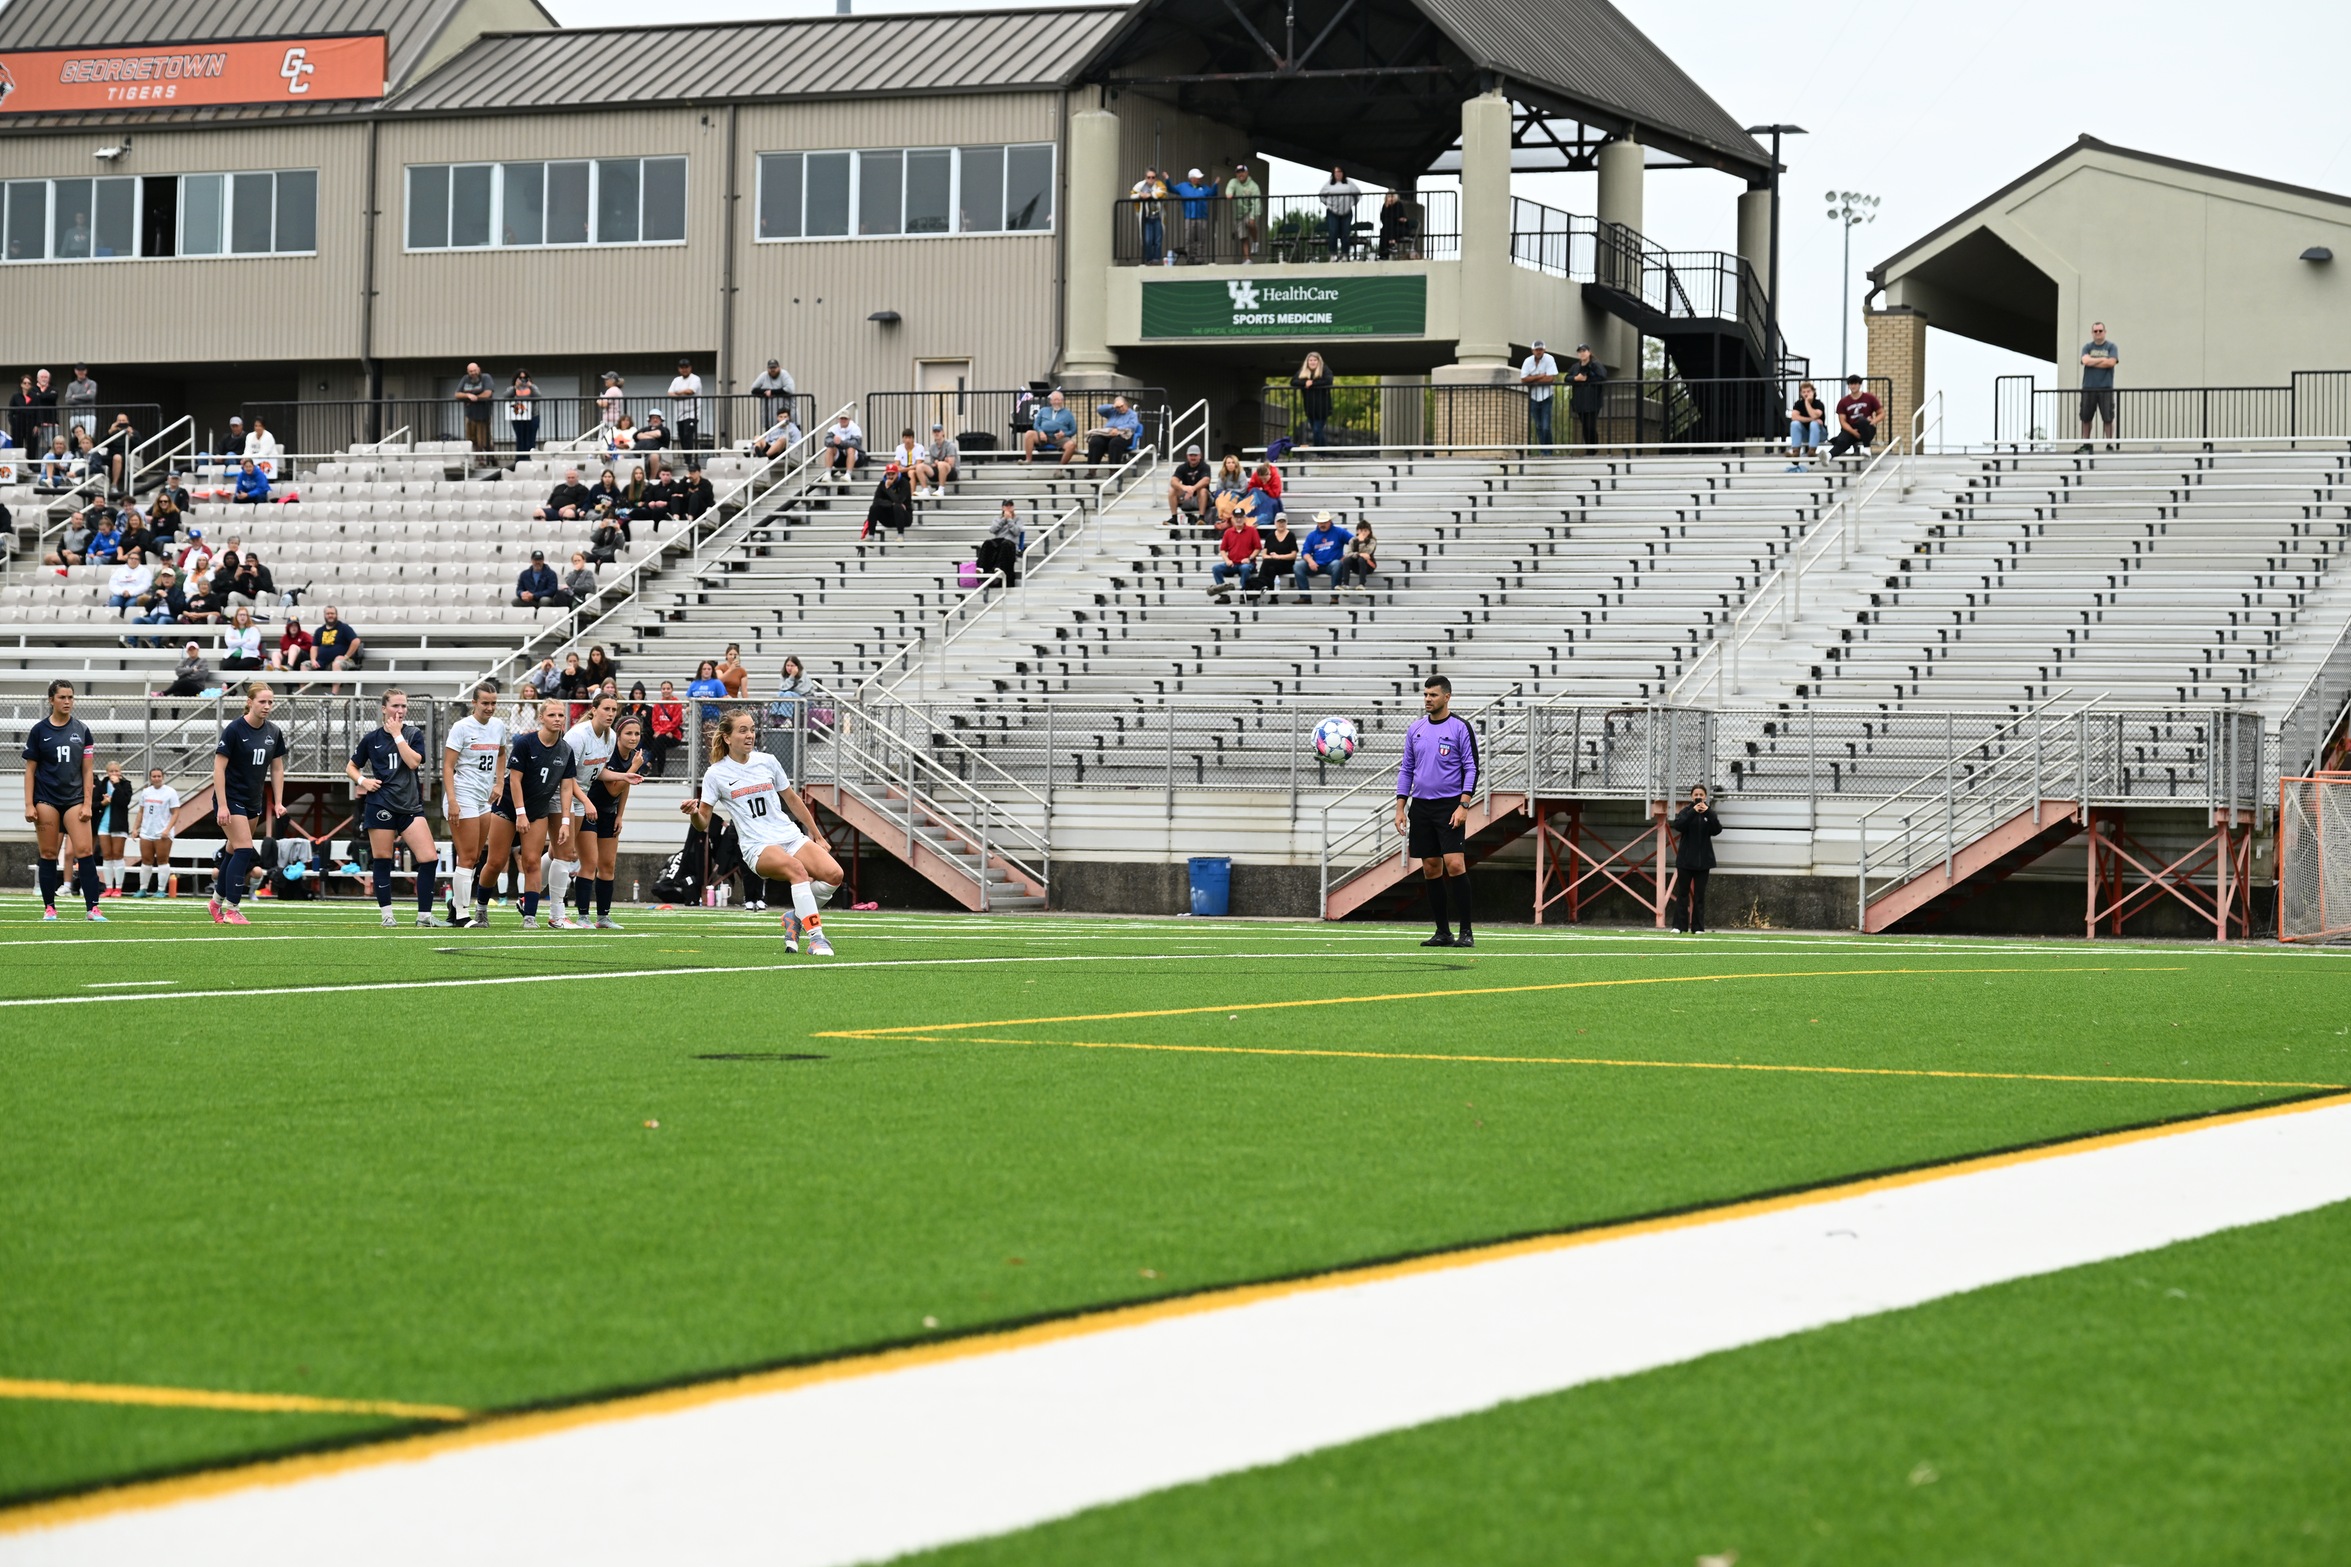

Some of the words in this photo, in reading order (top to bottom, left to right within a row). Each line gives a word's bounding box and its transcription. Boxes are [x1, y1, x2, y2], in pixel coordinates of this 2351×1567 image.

[59, 53, 227, 84] GEORGETOWN
[107, 85, 177, 100] TIGERS
[1227, 280, 1260, 310] UK
[1262, 286, 1339, 301] HealthCare
[1232, 313, 1275, 325] SPORTS
[1277, 313, 1333, 324] MEDICINE
[56, 745, 70, 763] 19
[252, 748, 266, 765] 10
[388, 752, 398, 769] 11
[478, 755, 494, 771] 22
[540, 766, 549, 784] 9
[590, 767, 599, 781] 2
[747, 796, 767, 819] 10
[809, 915, 819, 927] C
